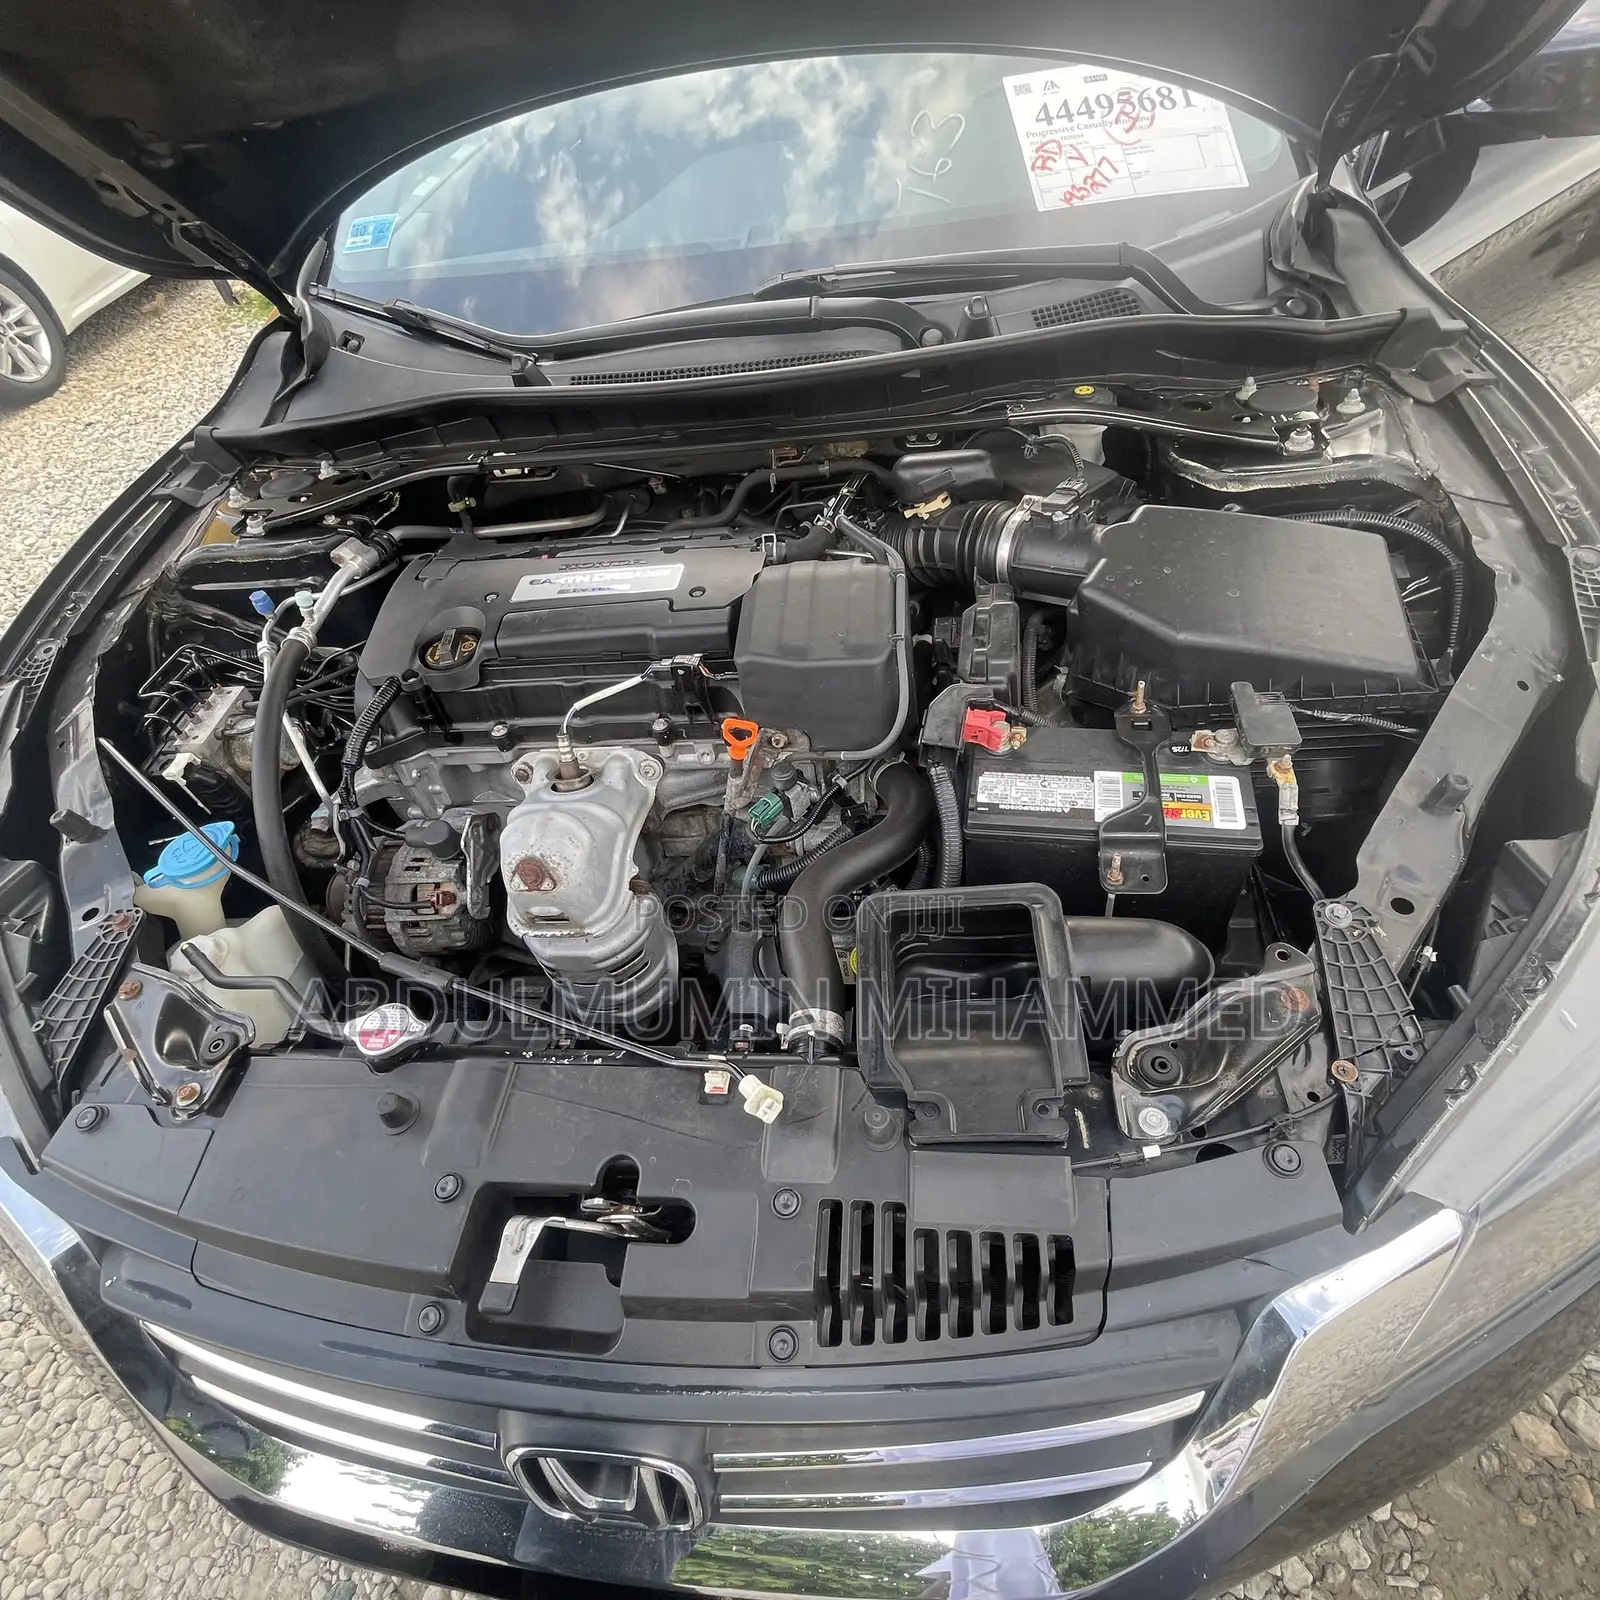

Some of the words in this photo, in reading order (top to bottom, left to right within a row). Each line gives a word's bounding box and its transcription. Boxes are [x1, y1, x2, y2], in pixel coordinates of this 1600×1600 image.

[1035, 86, 1198, 127] 44495681
[1026, 125, 1076, 139] Progressive
[1076, 119, 1113, 131] Casualty
[1164, 807, 1211, 821] EverSta
